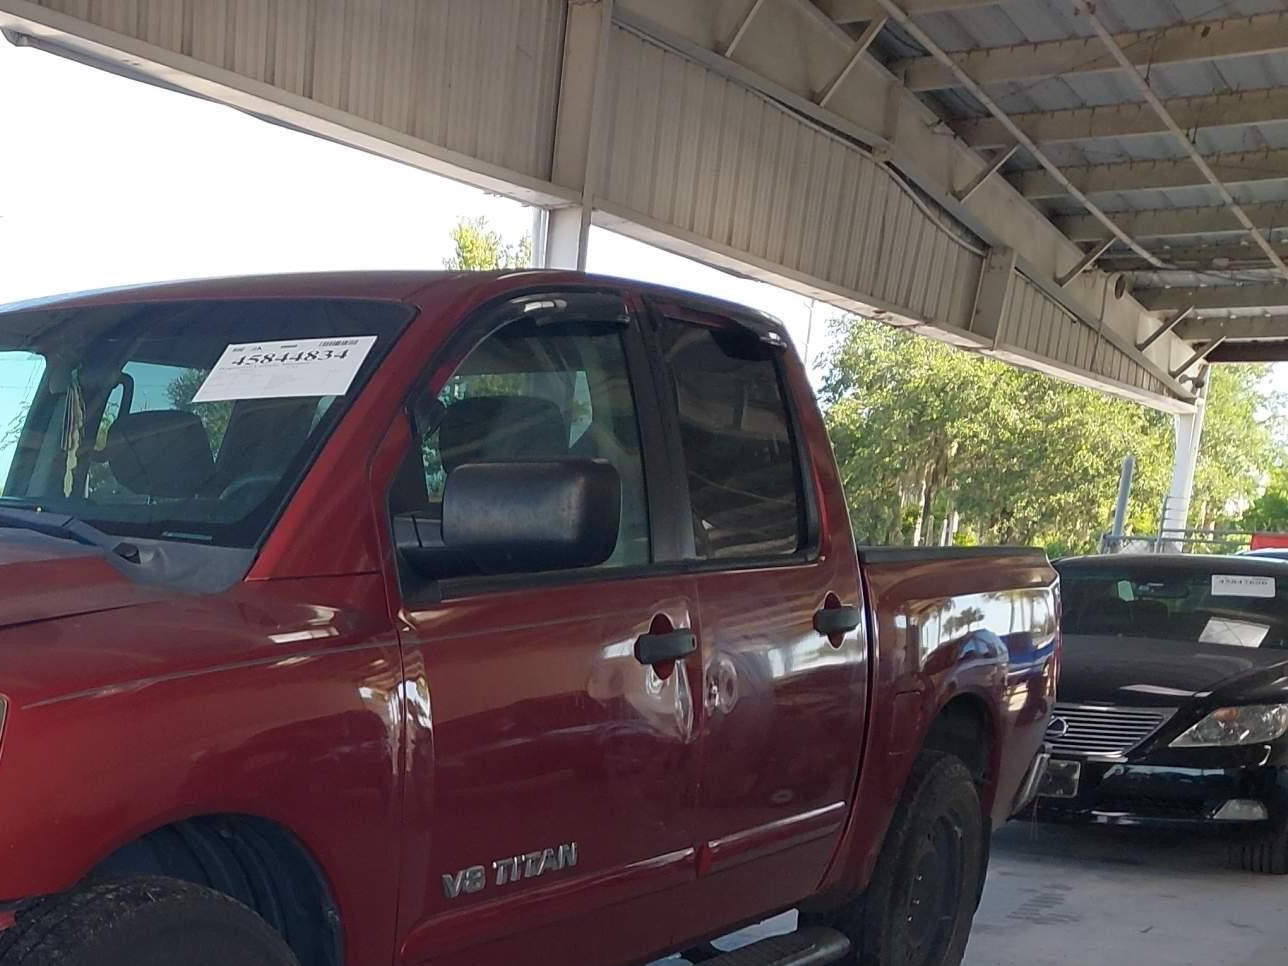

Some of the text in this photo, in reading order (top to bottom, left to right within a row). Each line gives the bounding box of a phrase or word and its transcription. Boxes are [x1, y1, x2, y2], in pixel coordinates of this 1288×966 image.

[231, 349, 349, 366] 45844834
[441, 842, 578, 898] V8 TITAN
